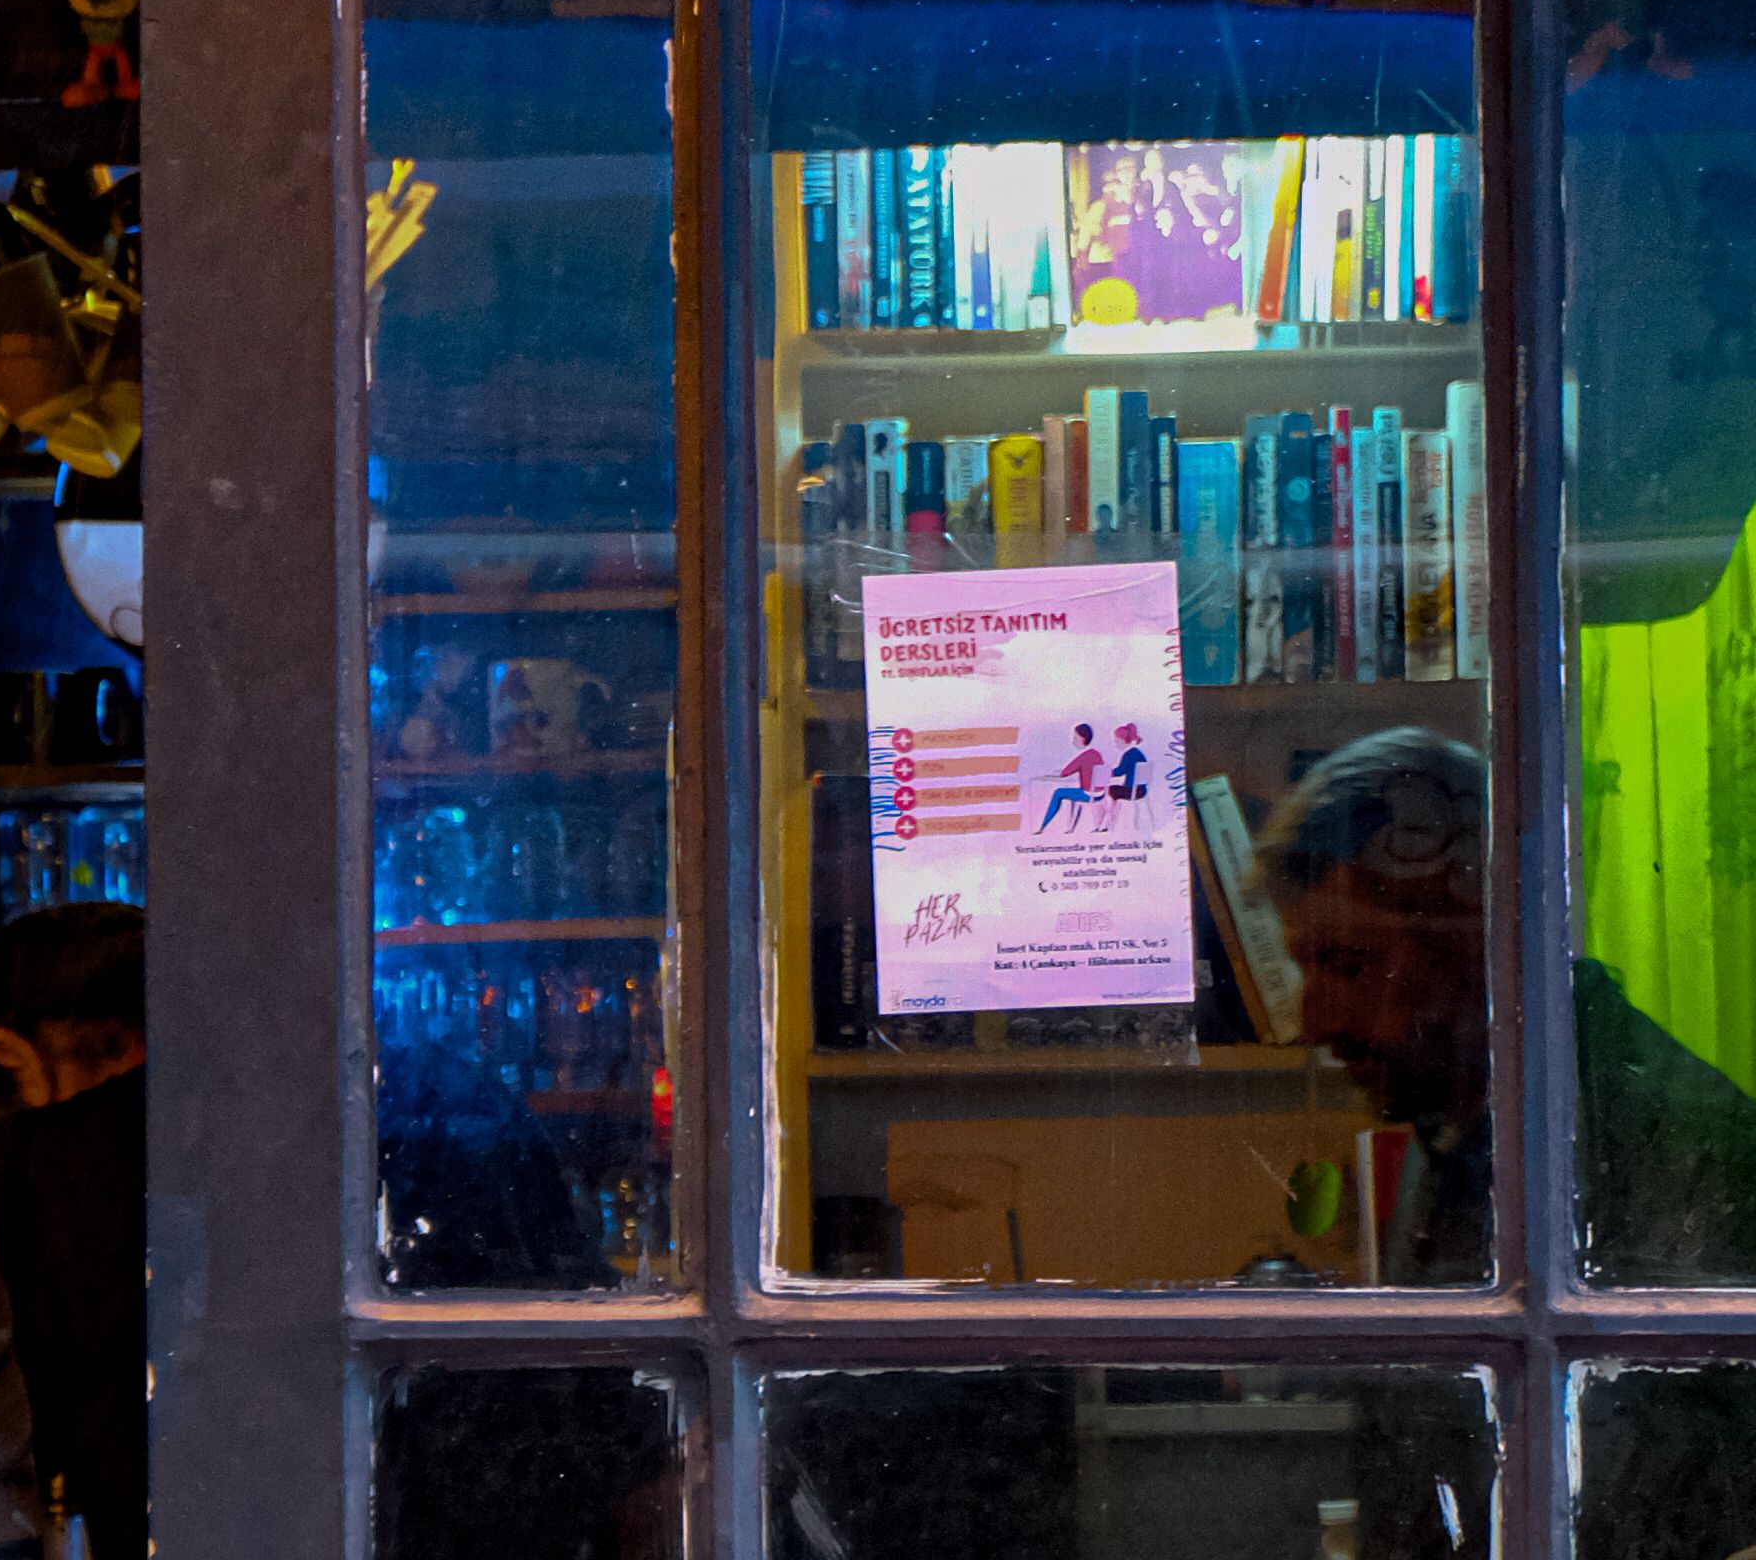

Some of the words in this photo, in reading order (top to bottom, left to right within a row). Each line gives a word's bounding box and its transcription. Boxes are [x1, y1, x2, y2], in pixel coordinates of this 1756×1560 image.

[879, 614, 976, 638] ÜCRETSİZ
[981, 613, 1068, 634] TANITIM
[880, 638, 977, 662] DERSLERİ
[913, 893, 961, 922] HER
